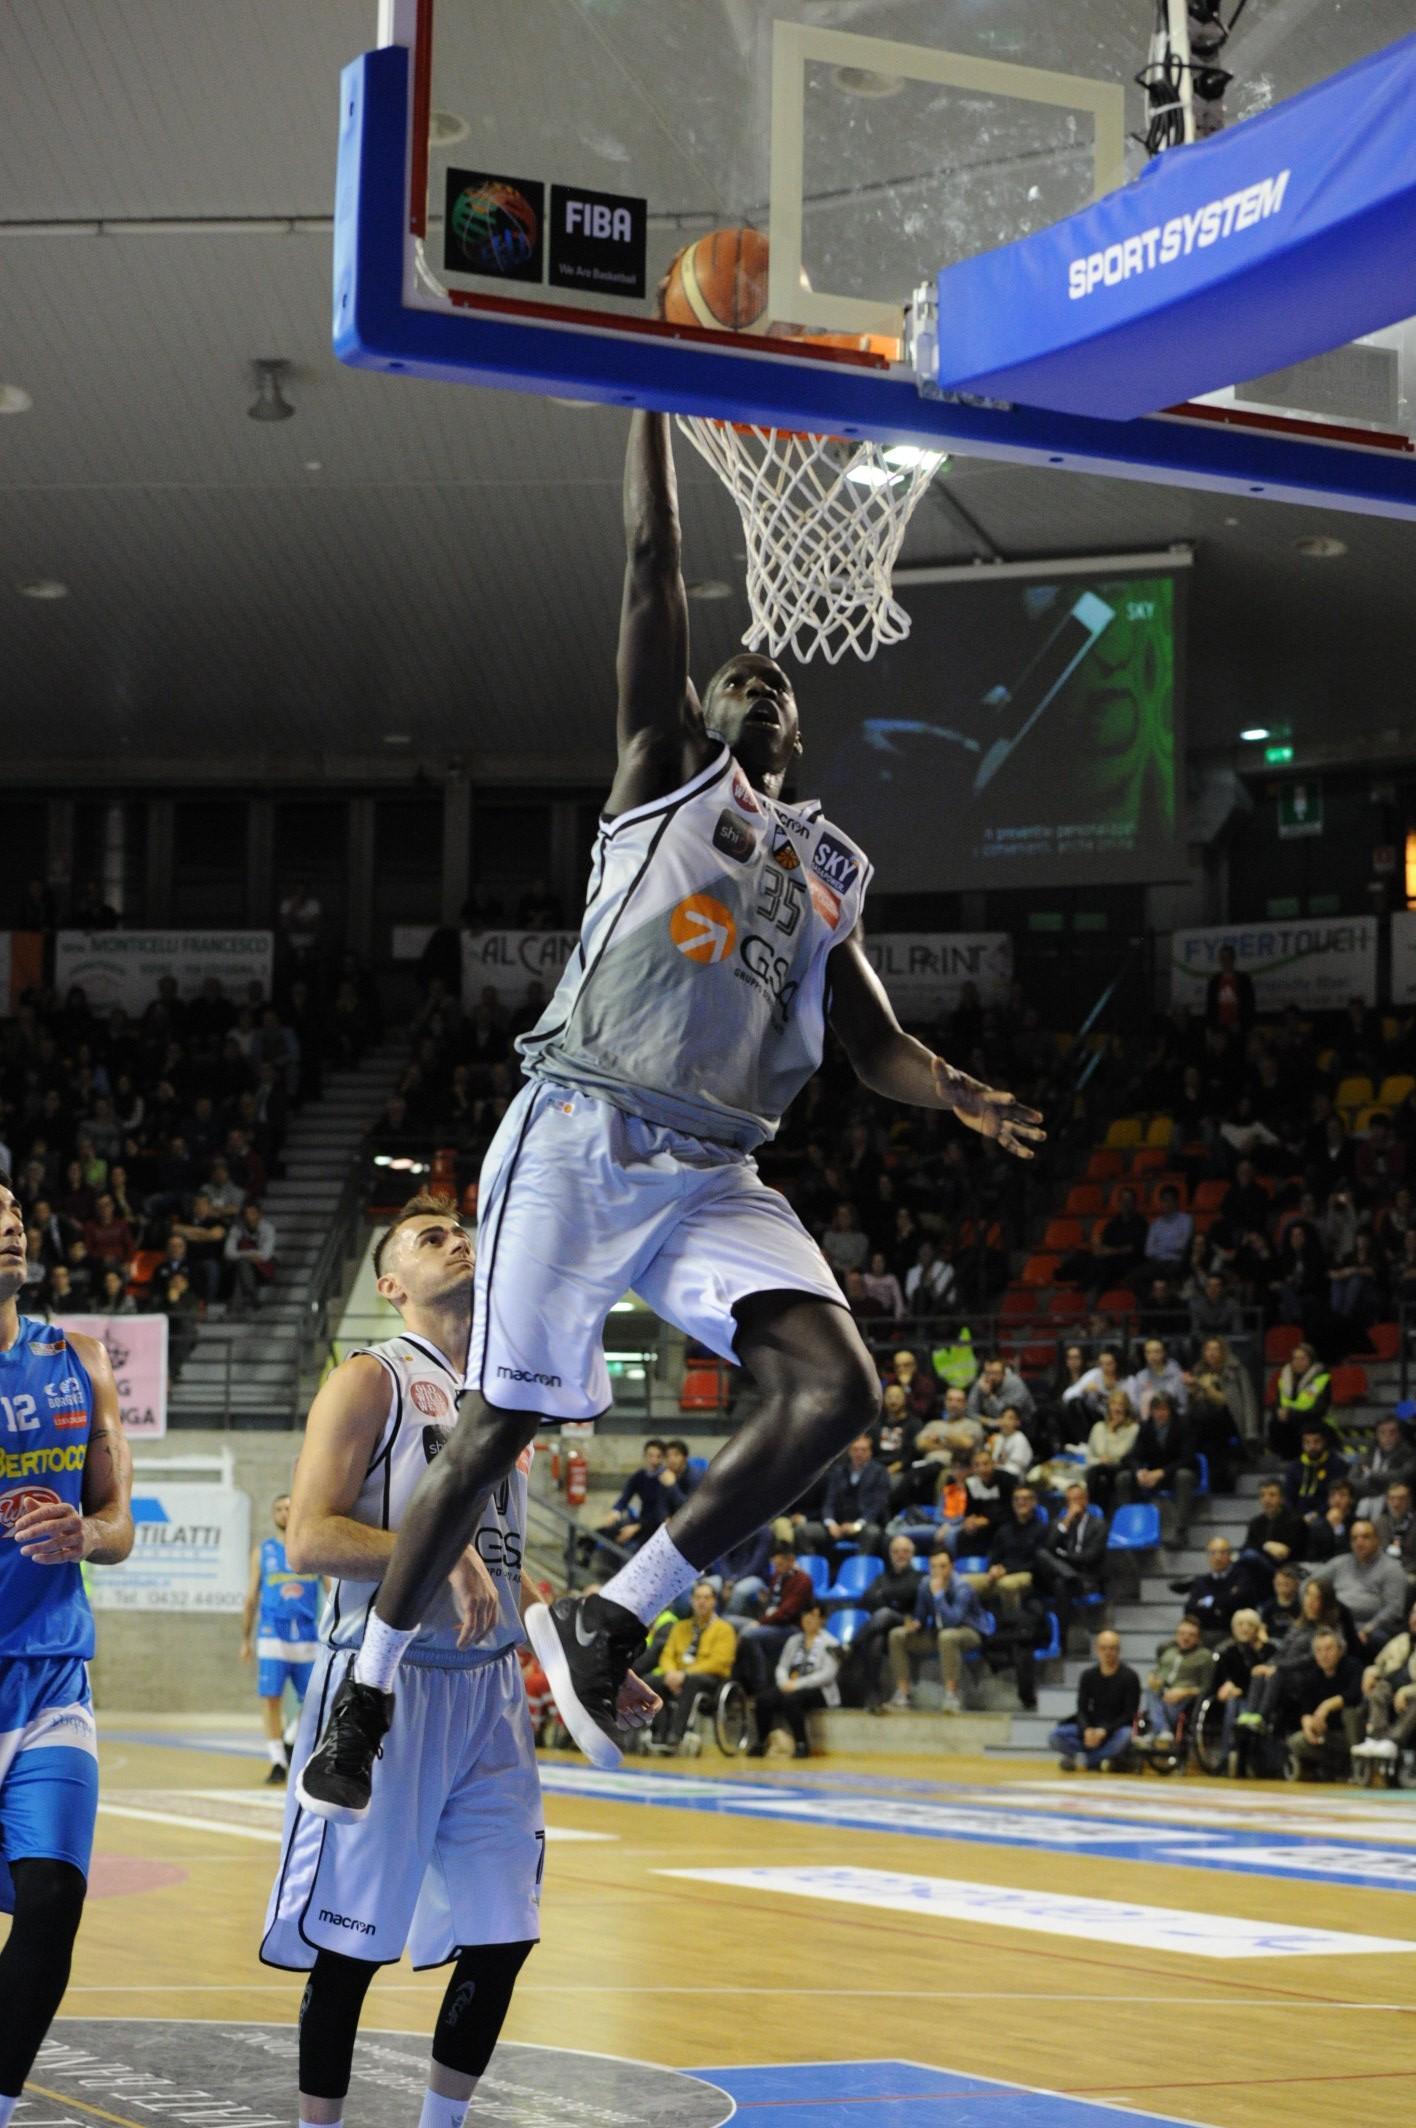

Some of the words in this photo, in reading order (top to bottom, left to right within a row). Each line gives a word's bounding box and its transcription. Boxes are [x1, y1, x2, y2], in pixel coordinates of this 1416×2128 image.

[565, 200, 632, 242] FIBA
[559, 263, 574, 276] We
[576, 265, 591, 278] Are
[593, 268, 636, 285] Basketball
[814, 843, 857, 883] SKY
[756, 864, 807, 937] 35
[183, 936, 269, 953] FRANCESCO
[496, 1365, 563, 1388] macron
[0, 1393, 41, 1433] 12
[475, 1526, 521, 1569] GS
[319, 1908, 377, 1937] macron
